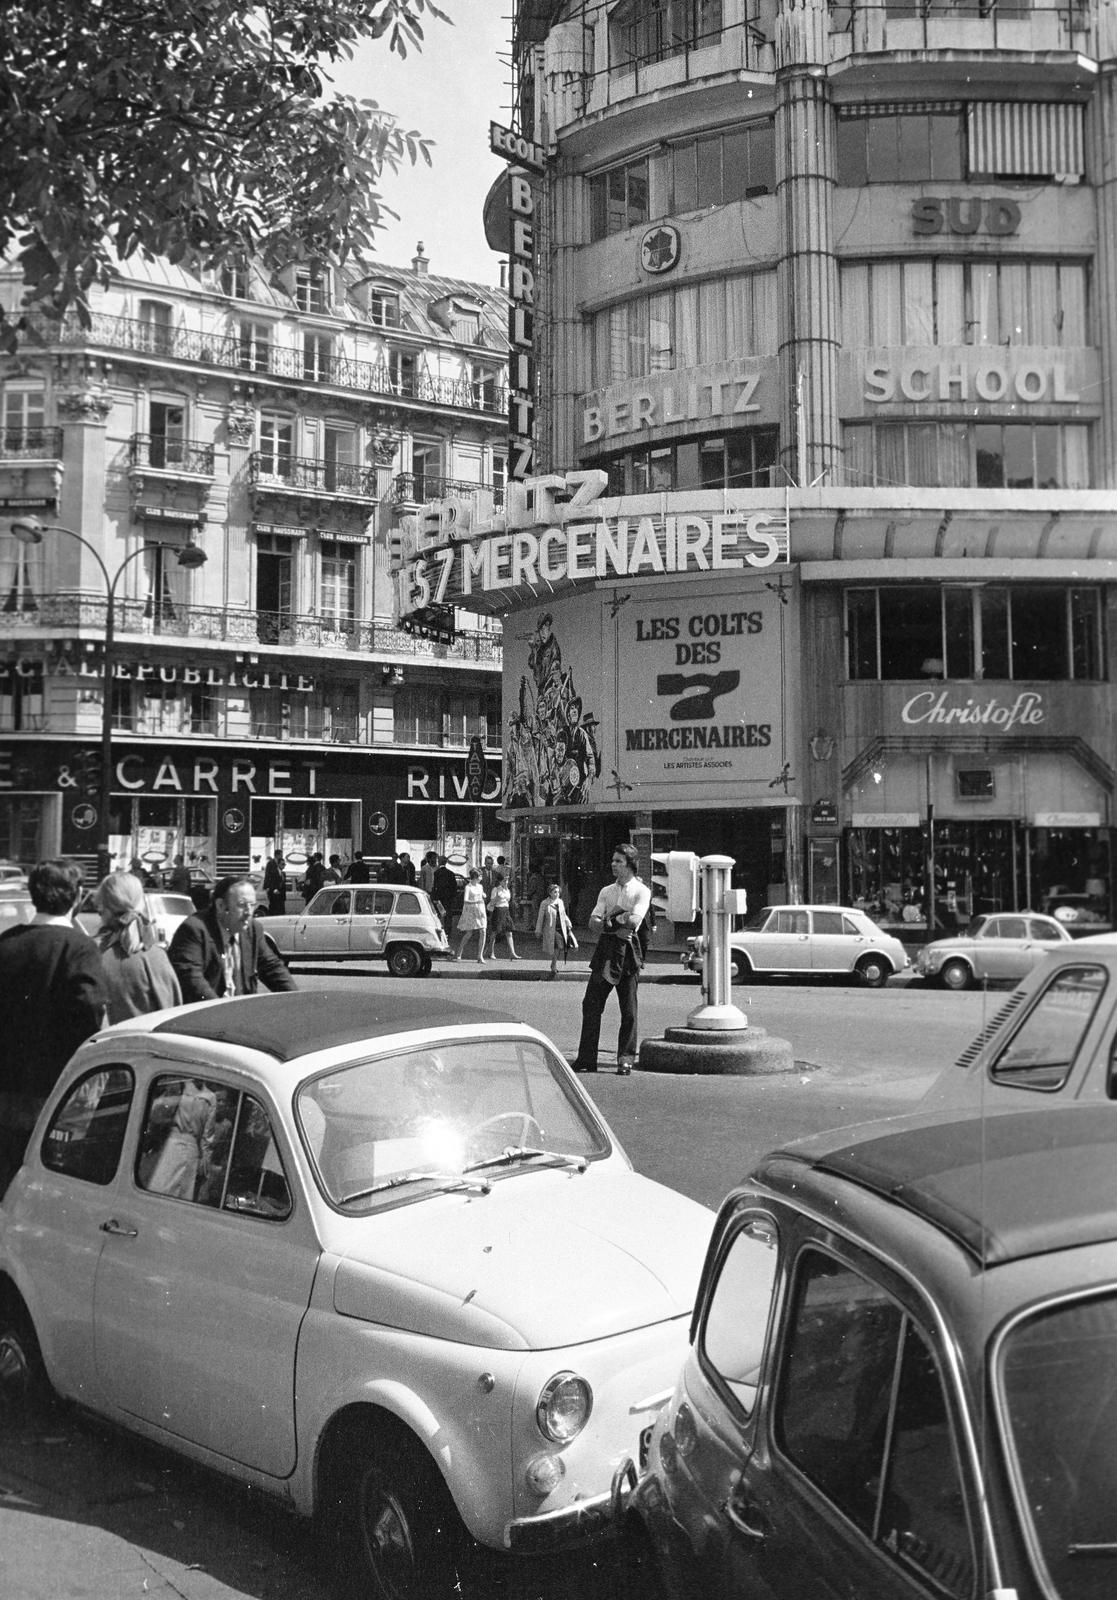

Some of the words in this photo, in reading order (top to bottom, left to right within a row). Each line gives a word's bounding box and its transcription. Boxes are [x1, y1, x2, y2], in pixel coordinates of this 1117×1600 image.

[493, 125, 546, 171] ECOLE
[911, 196, 1022, 237] SUD
[511, 175, 535, 479] BERLITZ
[583, 373, 762, 444] BERLITZ
[864, 363, 1081, 402] SCHOOL
[434, 547, 455, 604] 7
[461, 512, 780, 596] MERCENAIRES
[636, 617, 680, 641] LES
[688, 611, 763, 637] COLTS
[675, 641, 721, 665] DES
[656, 669, 741, 721] 7
[902, 691, 1046, 731] Christofle
[625, 724, 772, 751] MERCENAIRES
[57, 764, 78, 788] &
[115, 754, 326, 796] CARRET
[468, 742, 482, 796] TABAC
